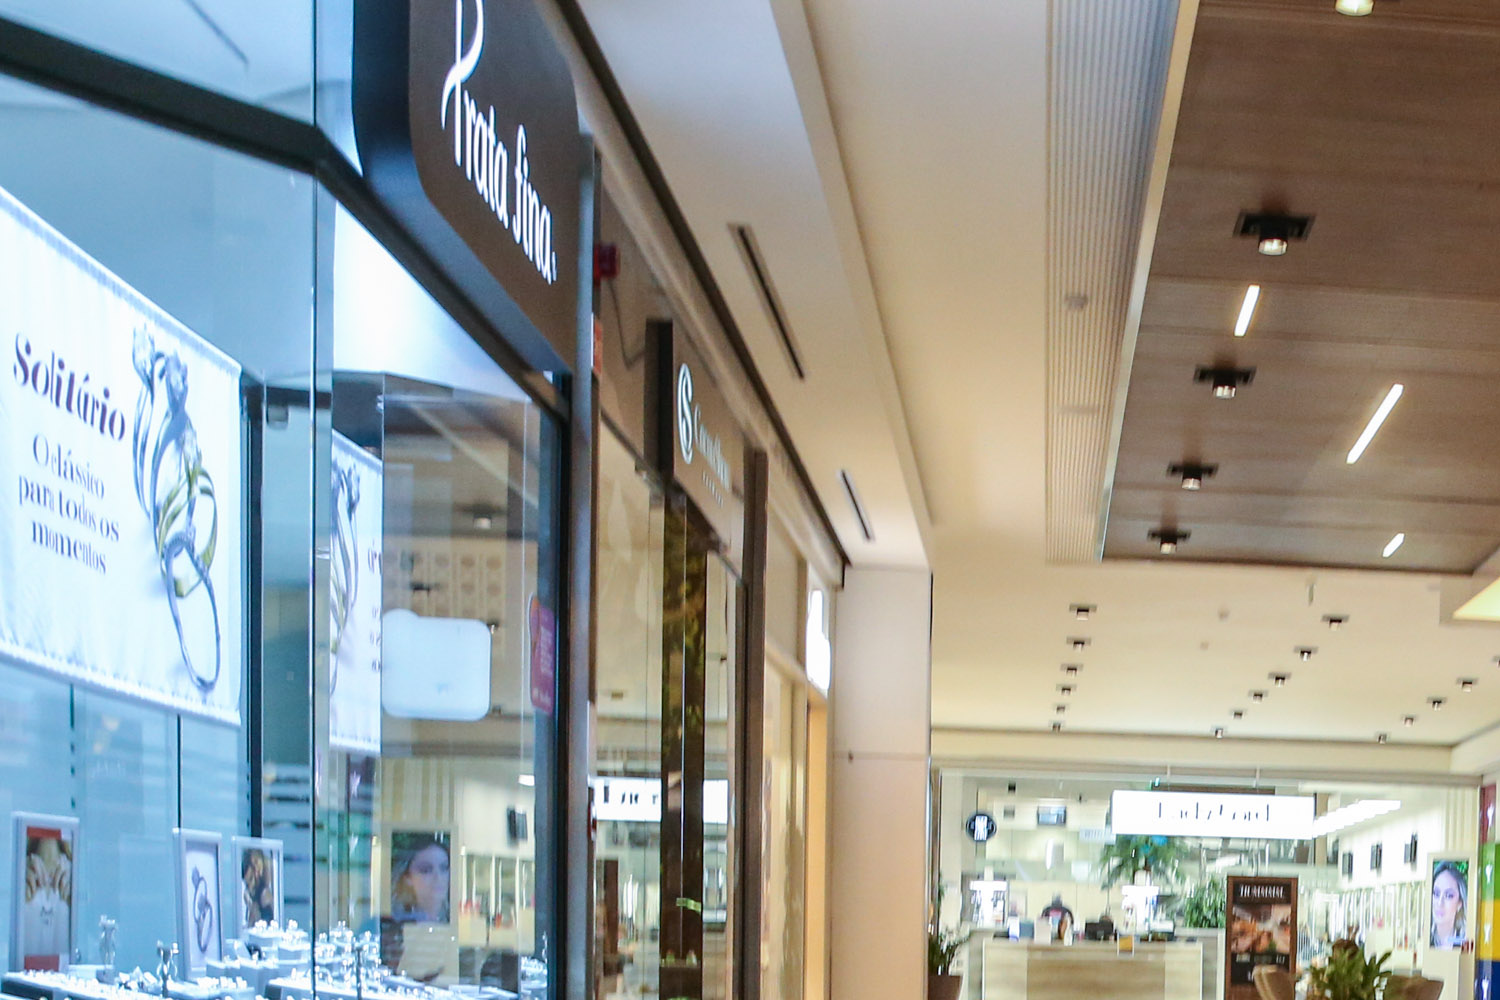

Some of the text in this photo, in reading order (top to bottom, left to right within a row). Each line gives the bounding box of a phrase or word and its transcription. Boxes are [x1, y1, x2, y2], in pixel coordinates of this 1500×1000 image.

[13, 332, 126, 441] Solitário
[33, 432, 105, 500] O clássico
[18, 474, 120, 542] para todos os
[32, 519, 106, 575] momentos
